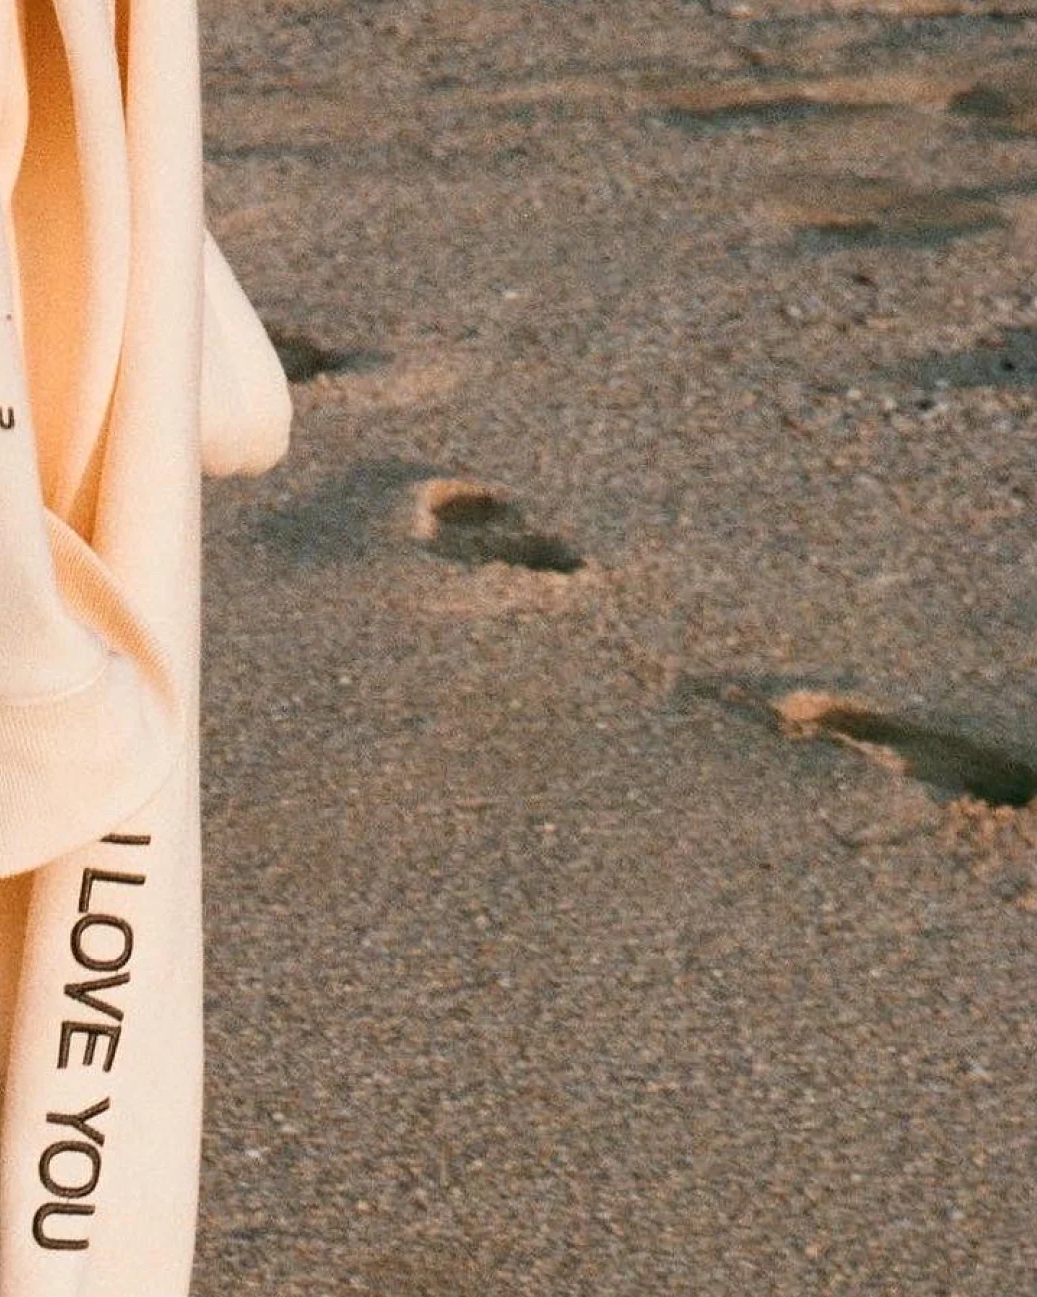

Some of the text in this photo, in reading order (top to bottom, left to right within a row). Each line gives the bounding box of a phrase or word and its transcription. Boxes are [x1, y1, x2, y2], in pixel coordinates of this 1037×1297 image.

[31, 833, 152, 1251] I LOVE YOU
